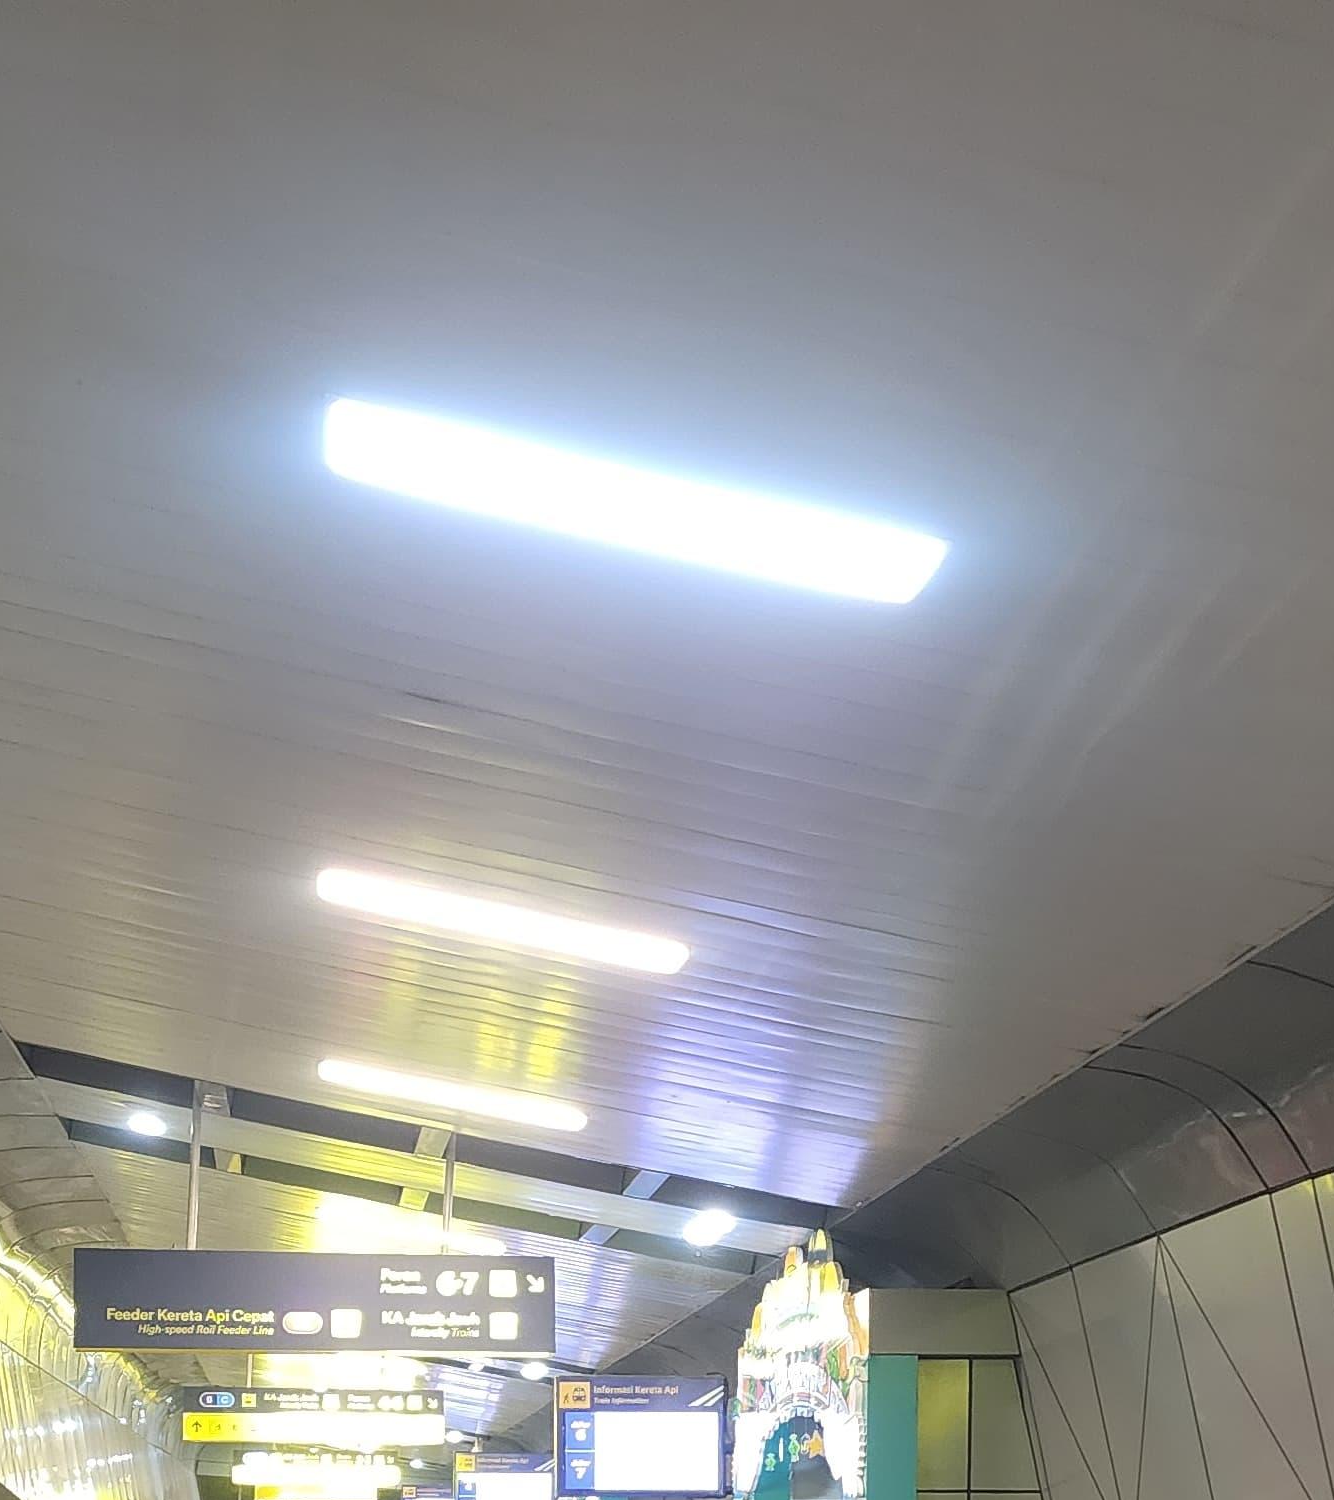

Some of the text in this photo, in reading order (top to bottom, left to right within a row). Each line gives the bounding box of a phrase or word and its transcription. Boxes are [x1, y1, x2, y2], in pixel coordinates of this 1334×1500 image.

[106, 1307, 275, 1325] Feeder Kereta Api Cepat
[137, 1323, 194, 1336] High-speed
[217, 1324, 252, 1336] Feeder
[253, 1325, 275, 1336] Line
[664, 1385, 679, 1396] Api
